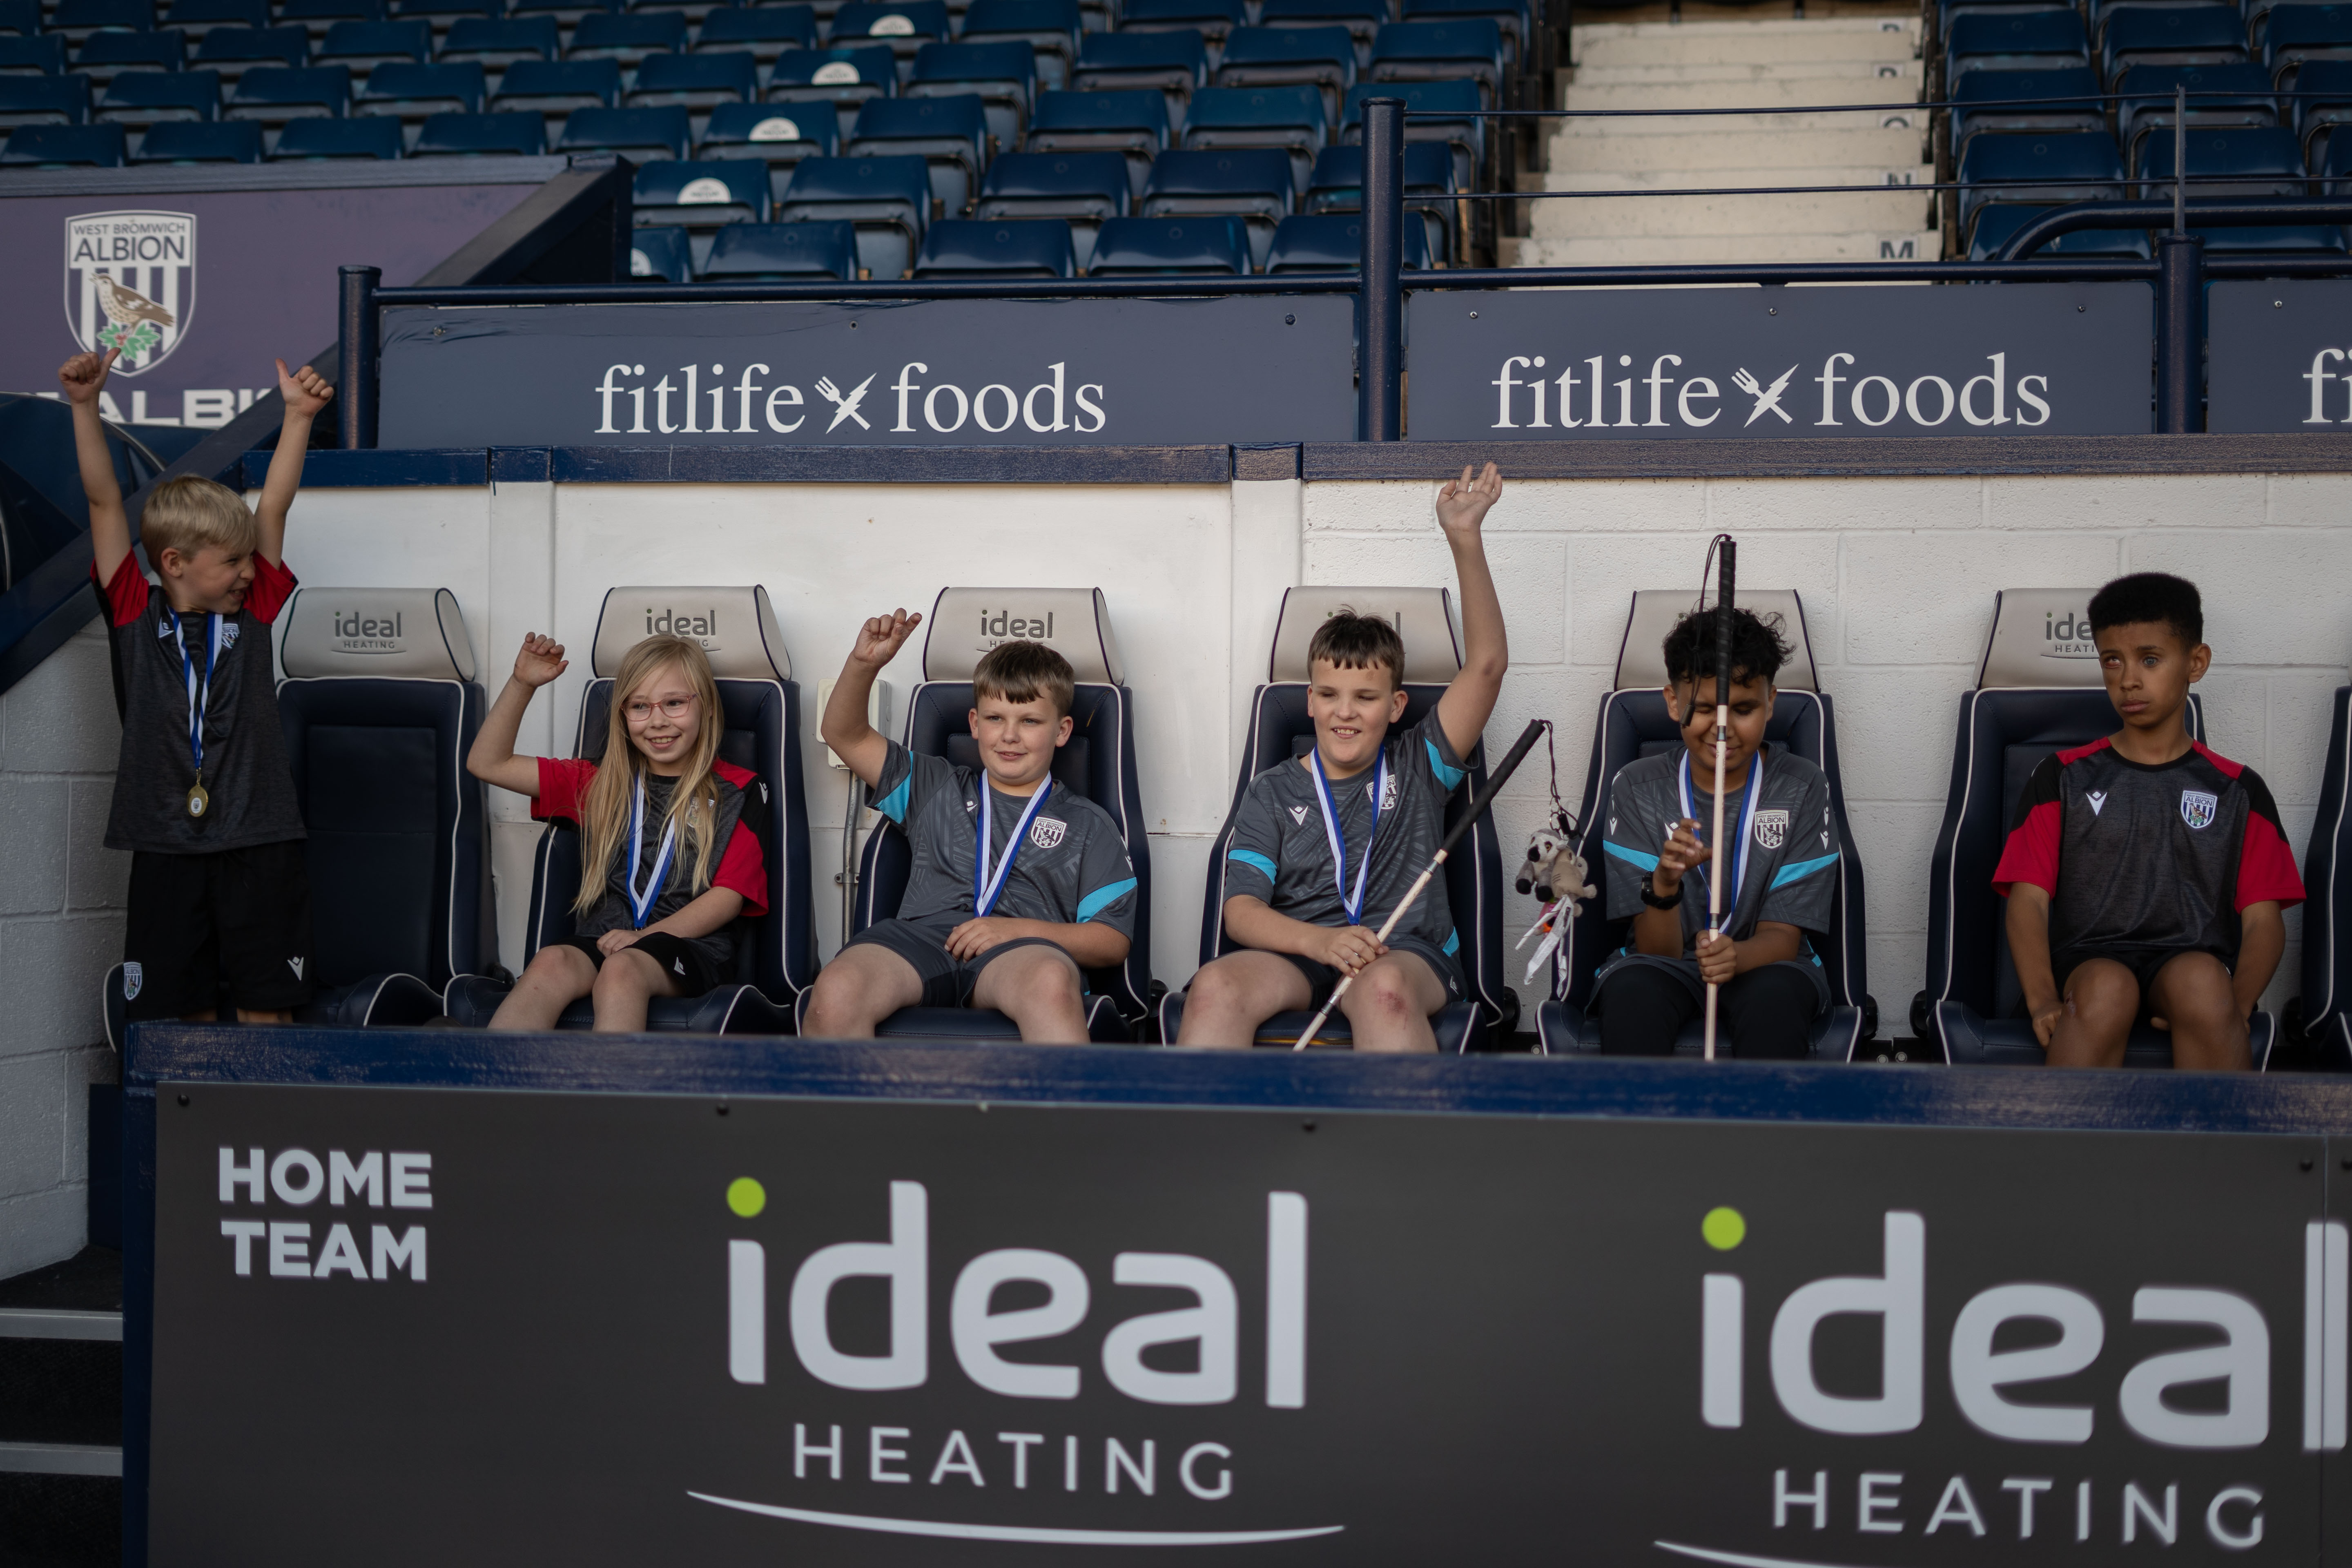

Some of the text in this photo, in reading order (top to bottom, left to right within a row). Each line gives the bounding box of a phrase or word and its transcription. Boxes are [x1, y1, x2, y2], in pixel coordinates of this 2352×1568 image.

[74, 222, 185, 235] WEST BROMWICH
[73, 236, 184, 262] ALBION
[1881, 241, 1914, 259] M
[595, 361, 1106, 434] fitlife foods
[1491, 352, 2051, 428] fitlife foods
[99, 389, 274, 427] ALB
[335, 611, 402, 638] ideal
[646, 609, 716, 636] ideal
[981, 609, 1053, 638] ideal
[2046, 612, 2093, 640] ide
[2185, 796, 2213, 806] ALBION
[1037, 822, 1062, 832] ALBION
[219, 1148, 433, 1207] HOME
[221, 1221, 426, 1280] TEAM
[727, 1177, 1307, 1409] ideal
[1702, 1207, 2349, 1451] ideal
[794, 1423, 1232, 1501] HEATING
[1774, 1469, 2263, 1548] HEATING
